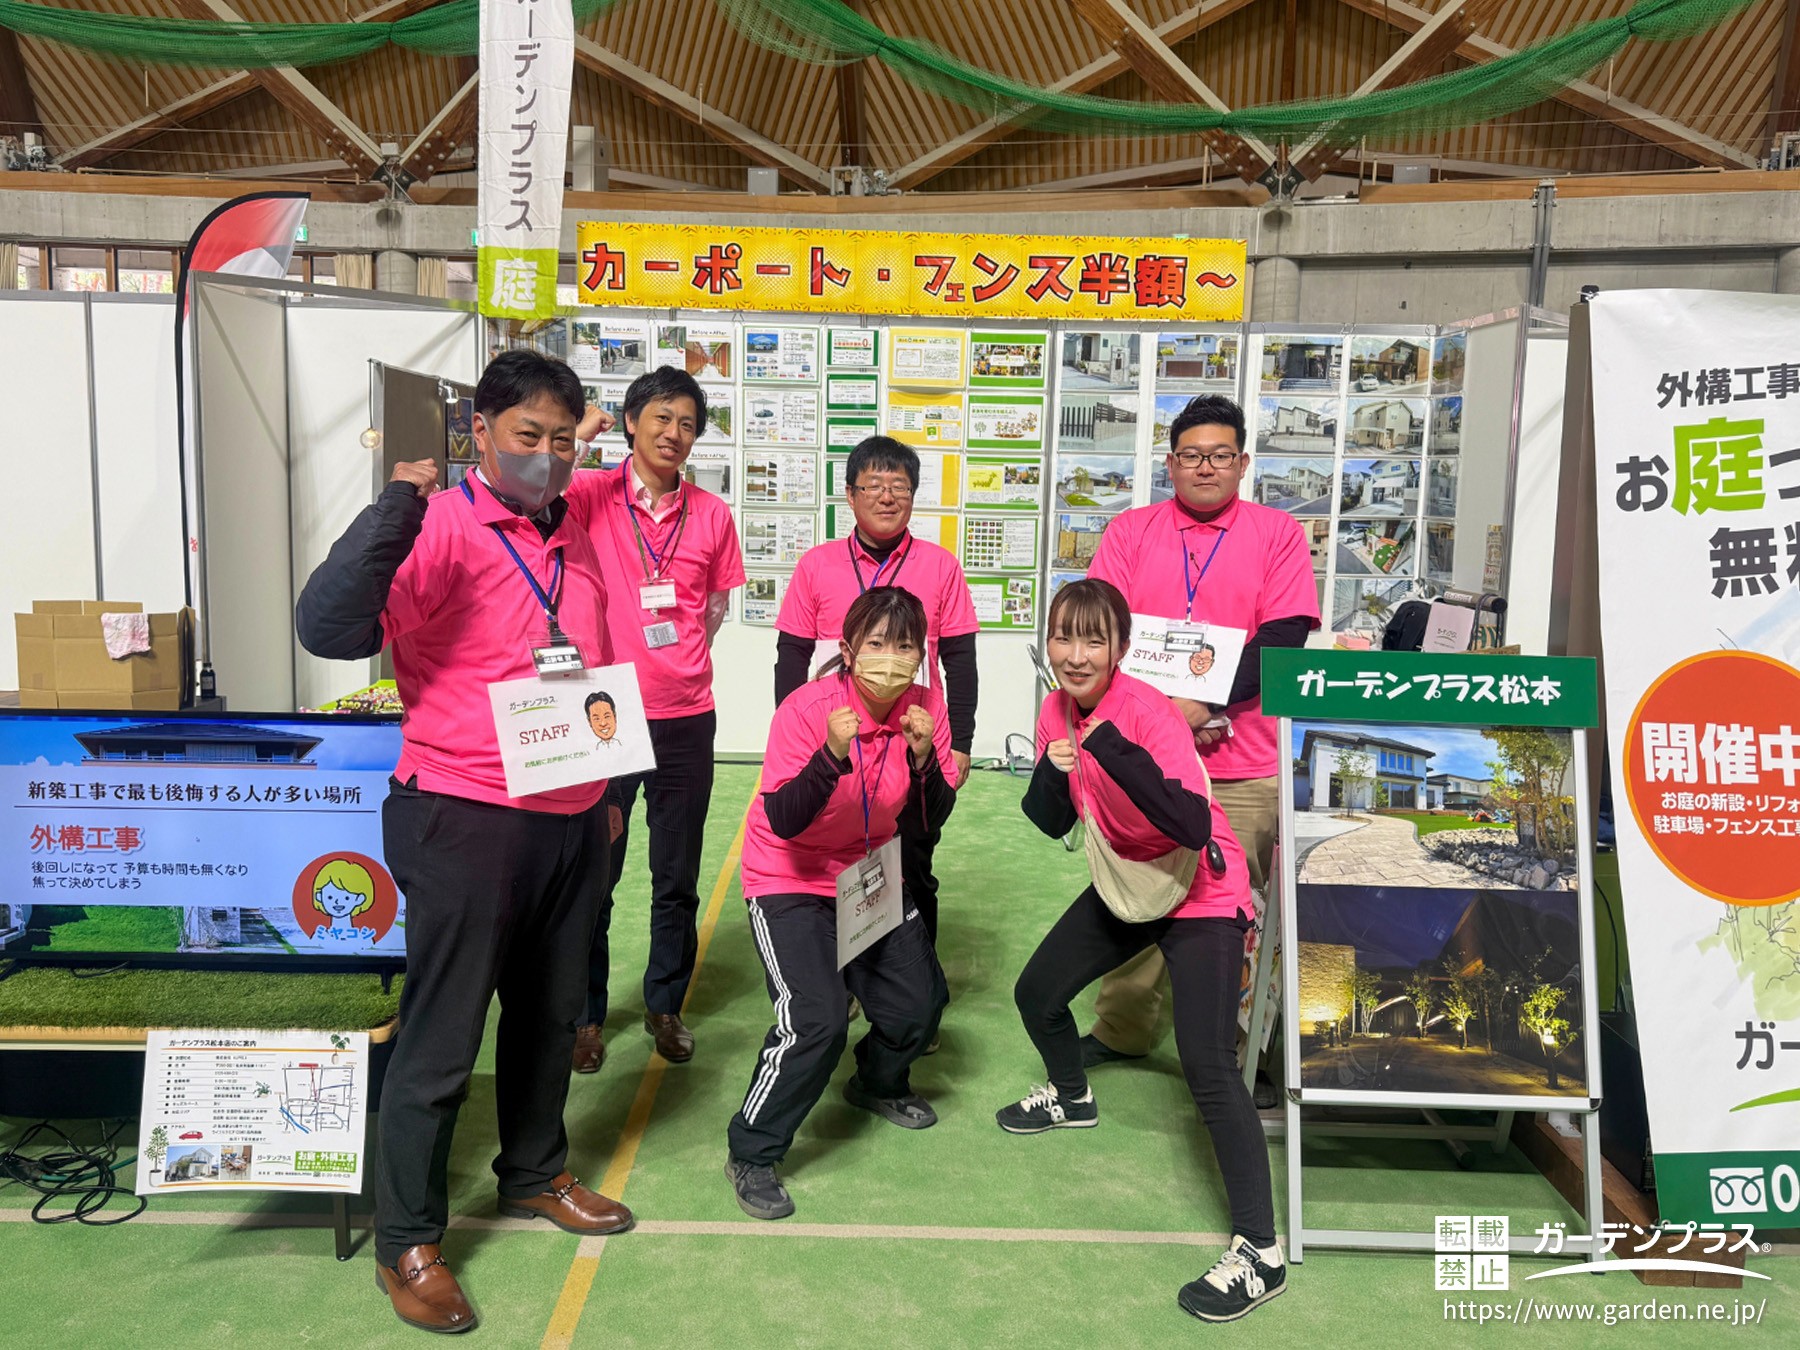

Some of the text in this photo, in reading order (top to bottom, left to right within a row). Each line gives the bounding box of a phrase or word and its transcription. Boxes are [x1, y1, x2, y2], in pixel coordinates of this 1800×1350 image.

[505, 0, 541, 232] ーデンプラス
[490, 258, 538, 311] 庭
[582, 241, 1238, 309] カーポート・フェンス半額～
[1656, 363, 1800, 409] 外構工事
[1709, 520, 1800, 600] 無
[1133, 648, 1174, 663] STAFF
[509, 696, 556, 711] ガーデンプラス
[1297, 668, 1561, 706] ガーデンプラス松本
[519, 723, 571, 745] STAFF
[1641, 721, 1800, 787] 開催中
[28, 781, 362, 804] 新築工事で最も後悔する人が多い場所
[30, 824, 141, 852] 外構工事
[31, 860, 249, 877] 後回しになって 予算も時間も無くなり
[32, 875, 142, 890] 焦って決めてしまう
[316, 925, 376, 941] ミヤコシ
[1771, 1164, 1800, 1214] 0
